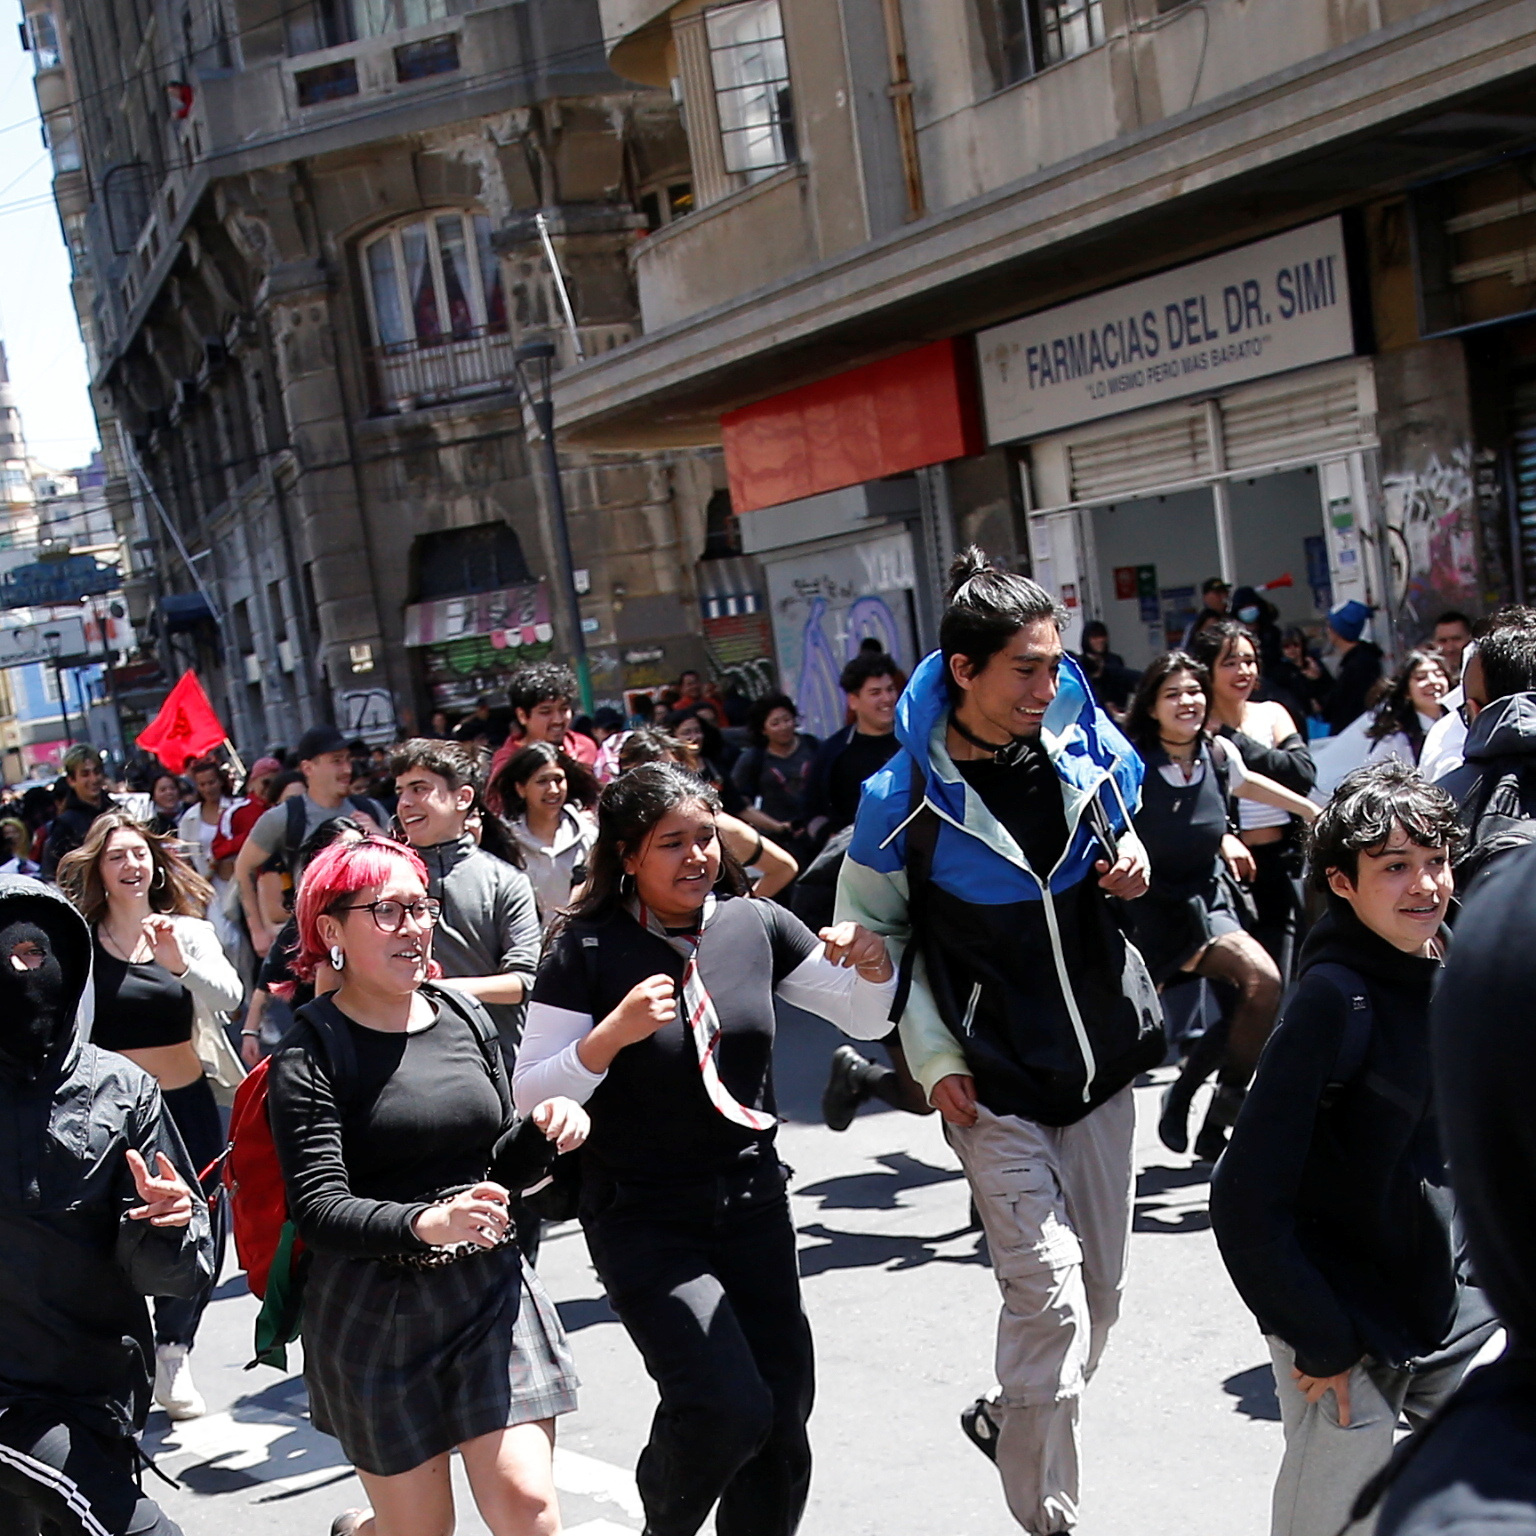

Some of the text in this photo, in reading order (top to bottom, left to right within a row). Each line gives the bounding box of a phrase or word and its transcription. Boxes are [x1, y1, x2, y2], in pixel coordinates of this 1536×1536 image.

[1026, 255, 1336, 390] FARMACIAS DEL DR. SIMI
